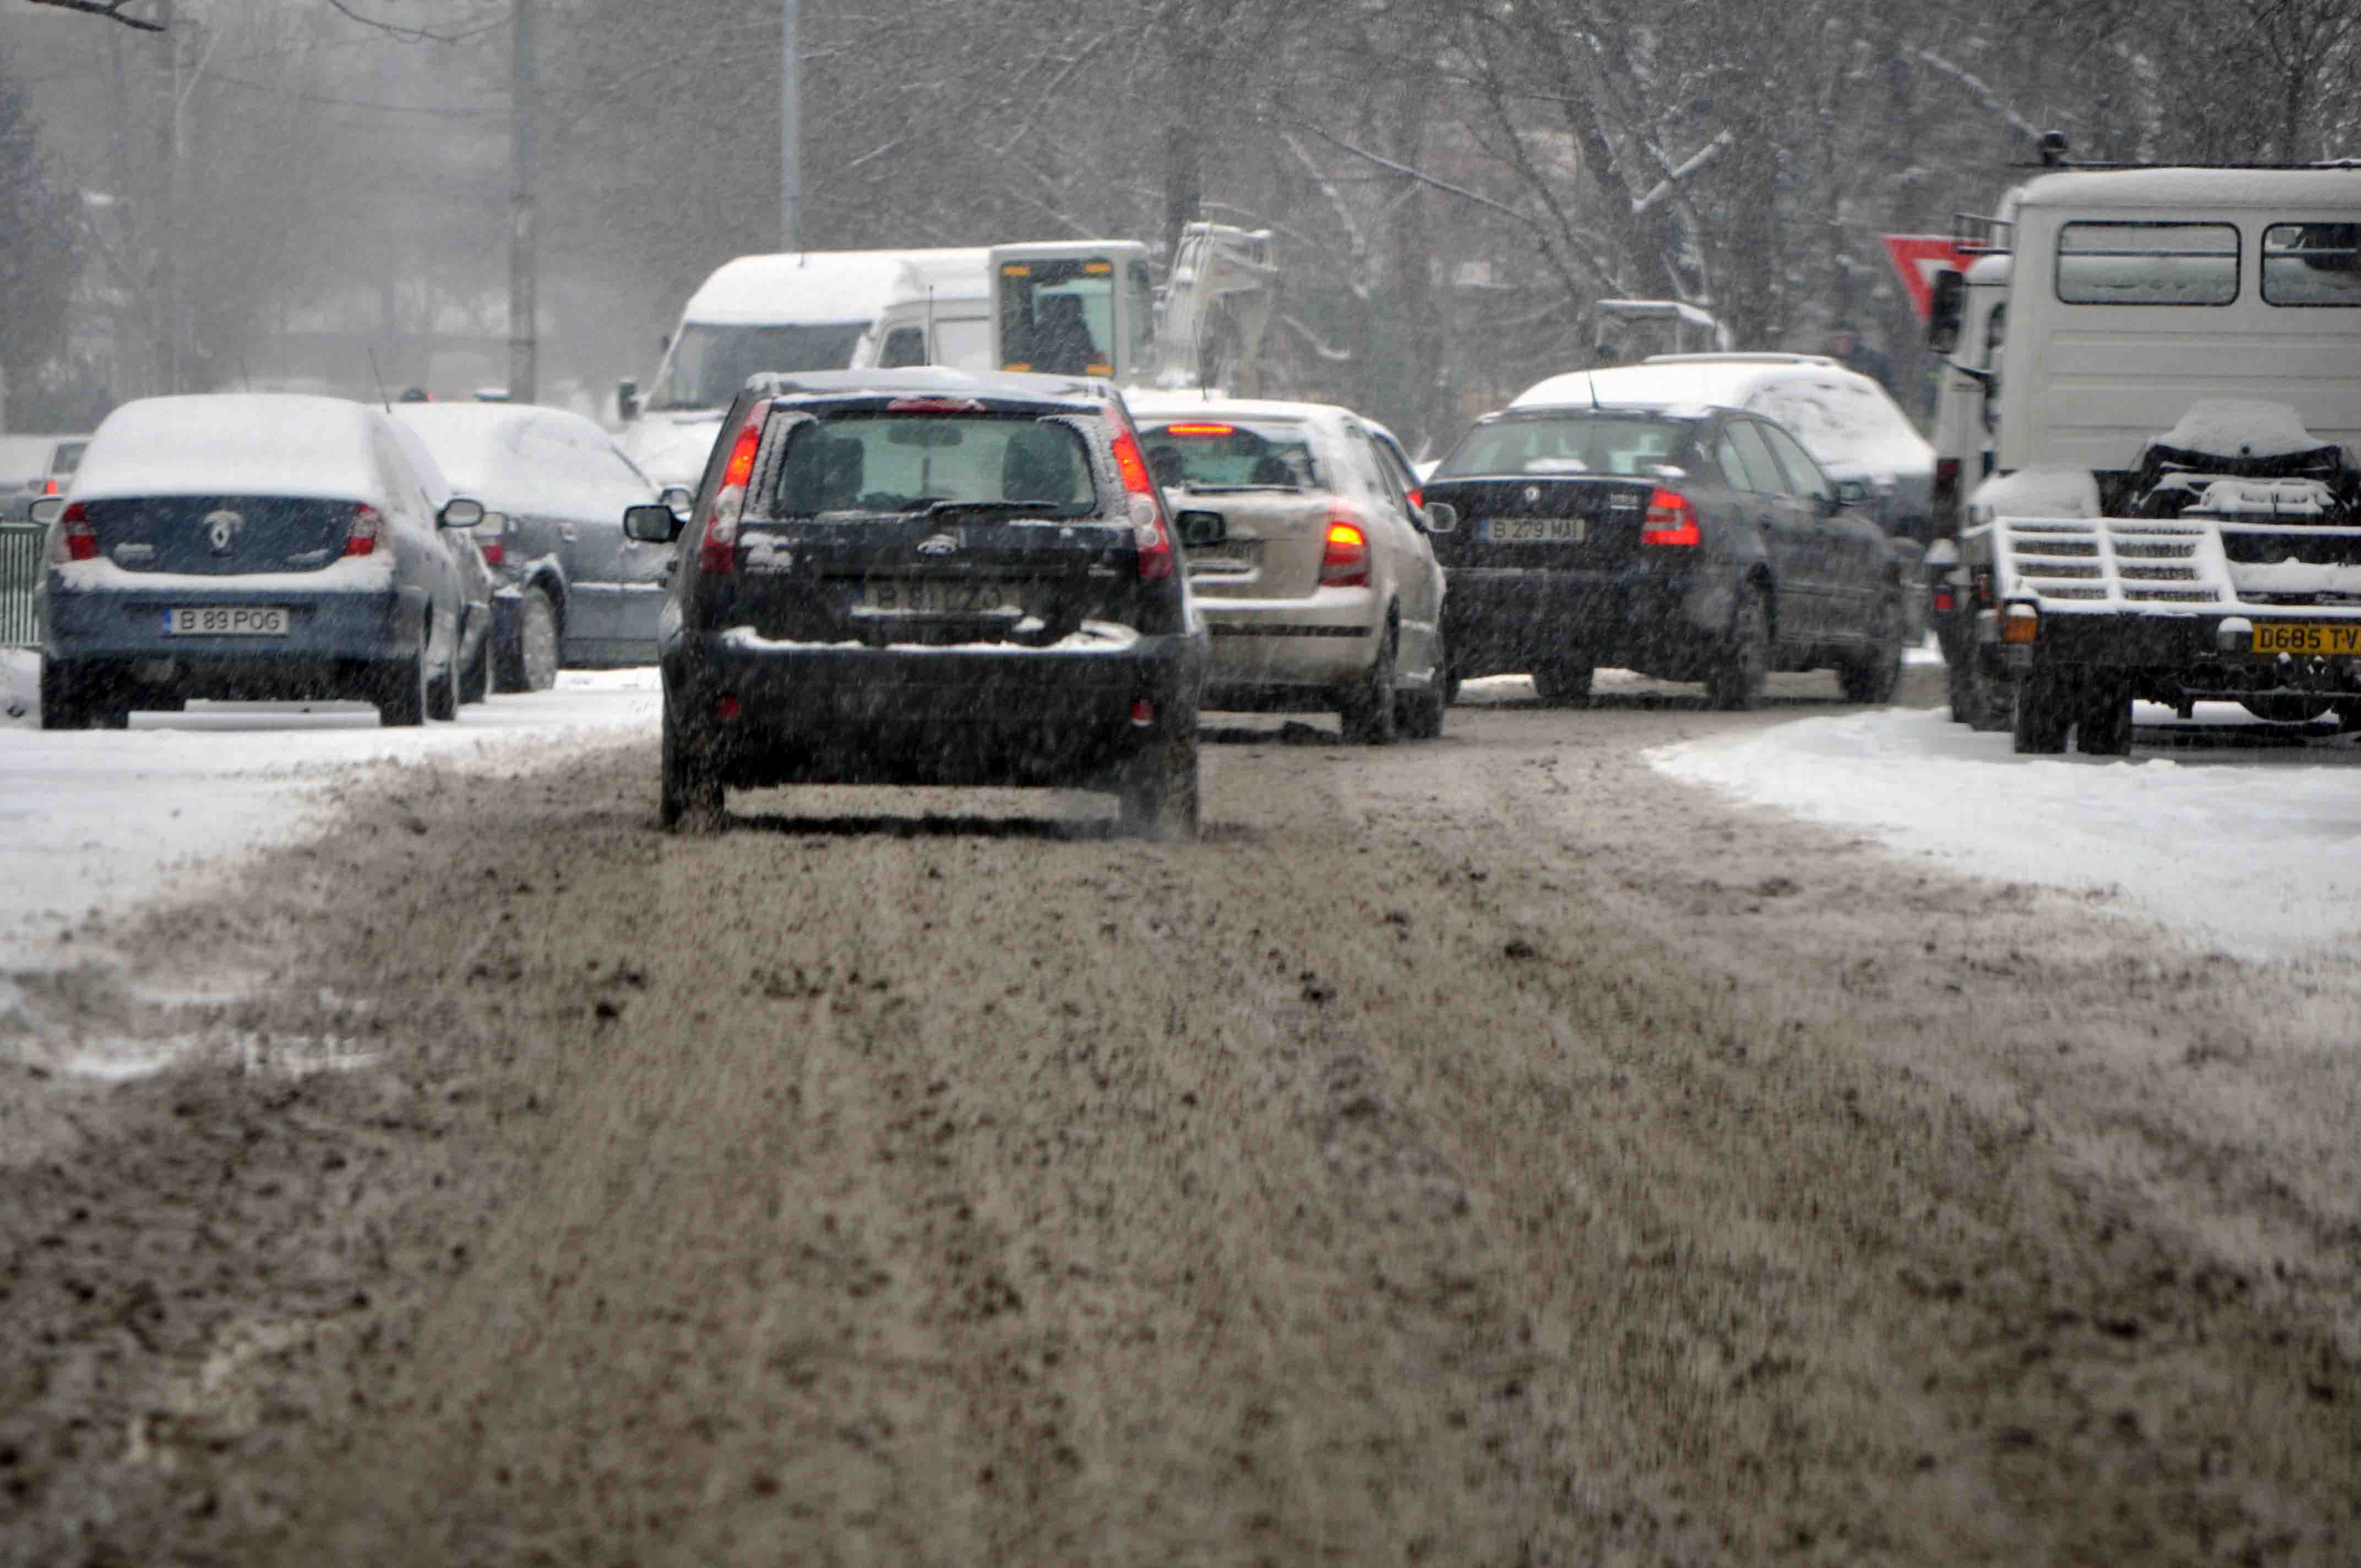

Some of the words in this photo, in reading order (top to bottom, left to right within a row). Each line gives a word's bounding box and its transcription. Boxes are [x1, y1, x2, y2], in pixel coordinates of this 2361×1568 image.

[1493, 520, 1506, 538] B
[180, 610, 195, 630] B
[234, 611, 280, 630] POG
[2260, 627, 2321, 649] D685
[2330, 628, 2359, 649] TV
